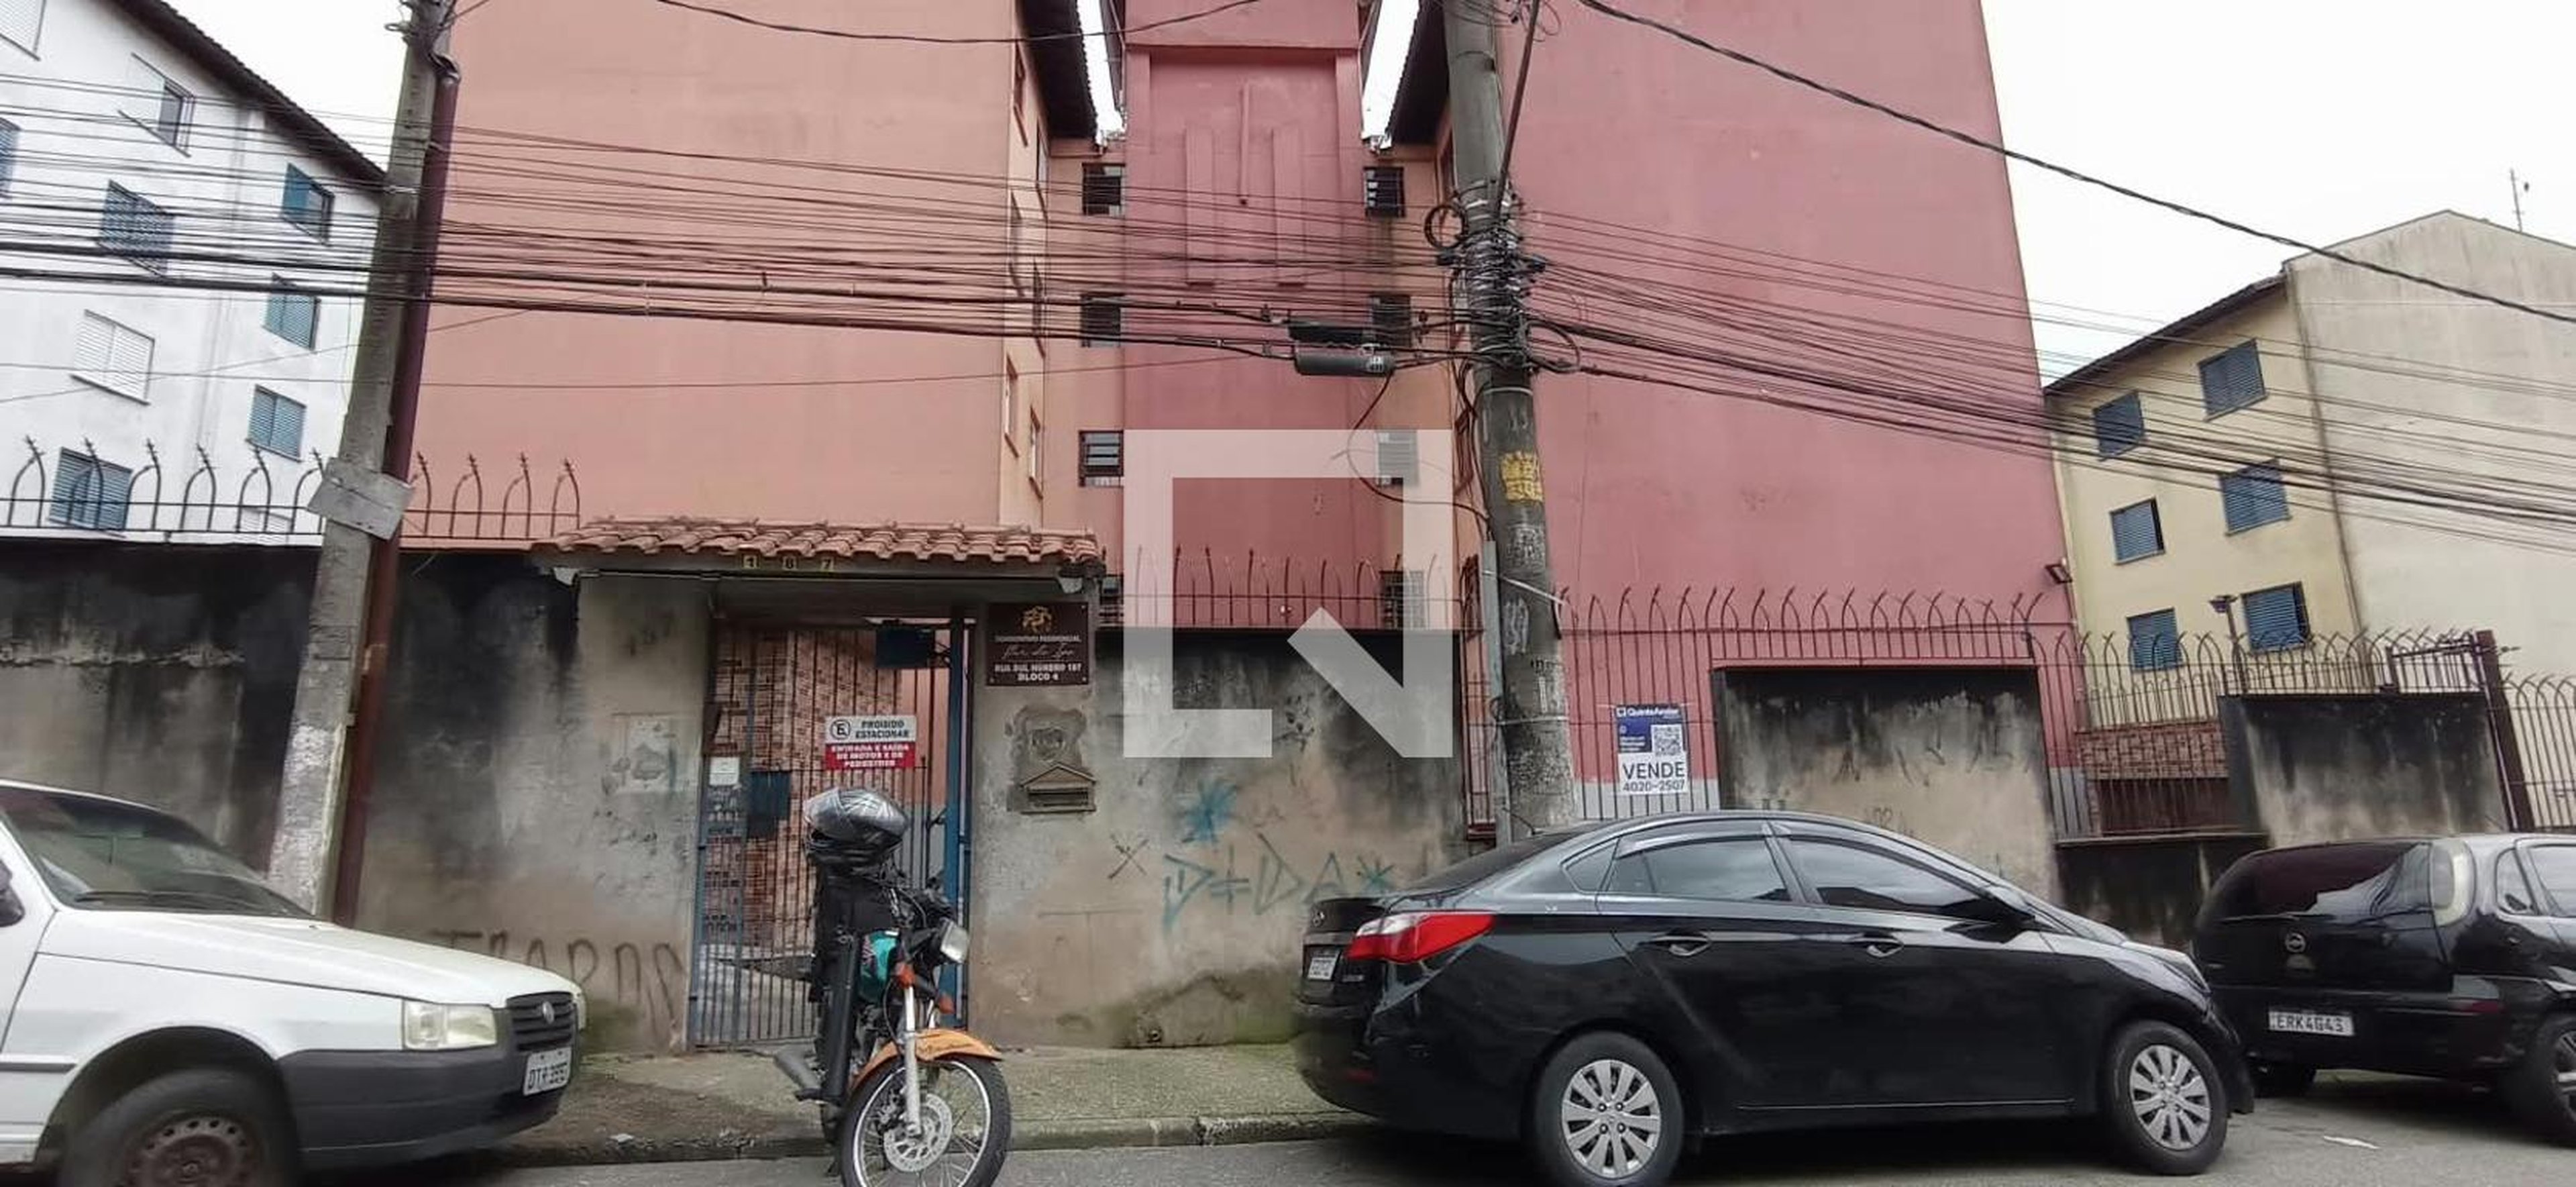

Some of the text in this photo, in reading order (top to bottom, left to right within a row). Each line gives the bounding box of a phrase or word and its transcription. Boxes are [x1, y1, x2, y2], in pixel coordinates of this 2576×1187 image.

[1018, 673, 1050, 682] BLOCO
[855, 729, 909, 739] ESTACIONAR
[1622, 762, 1685, 780] VENDE
[1622, 779, 1684, 792] 4020-2507
